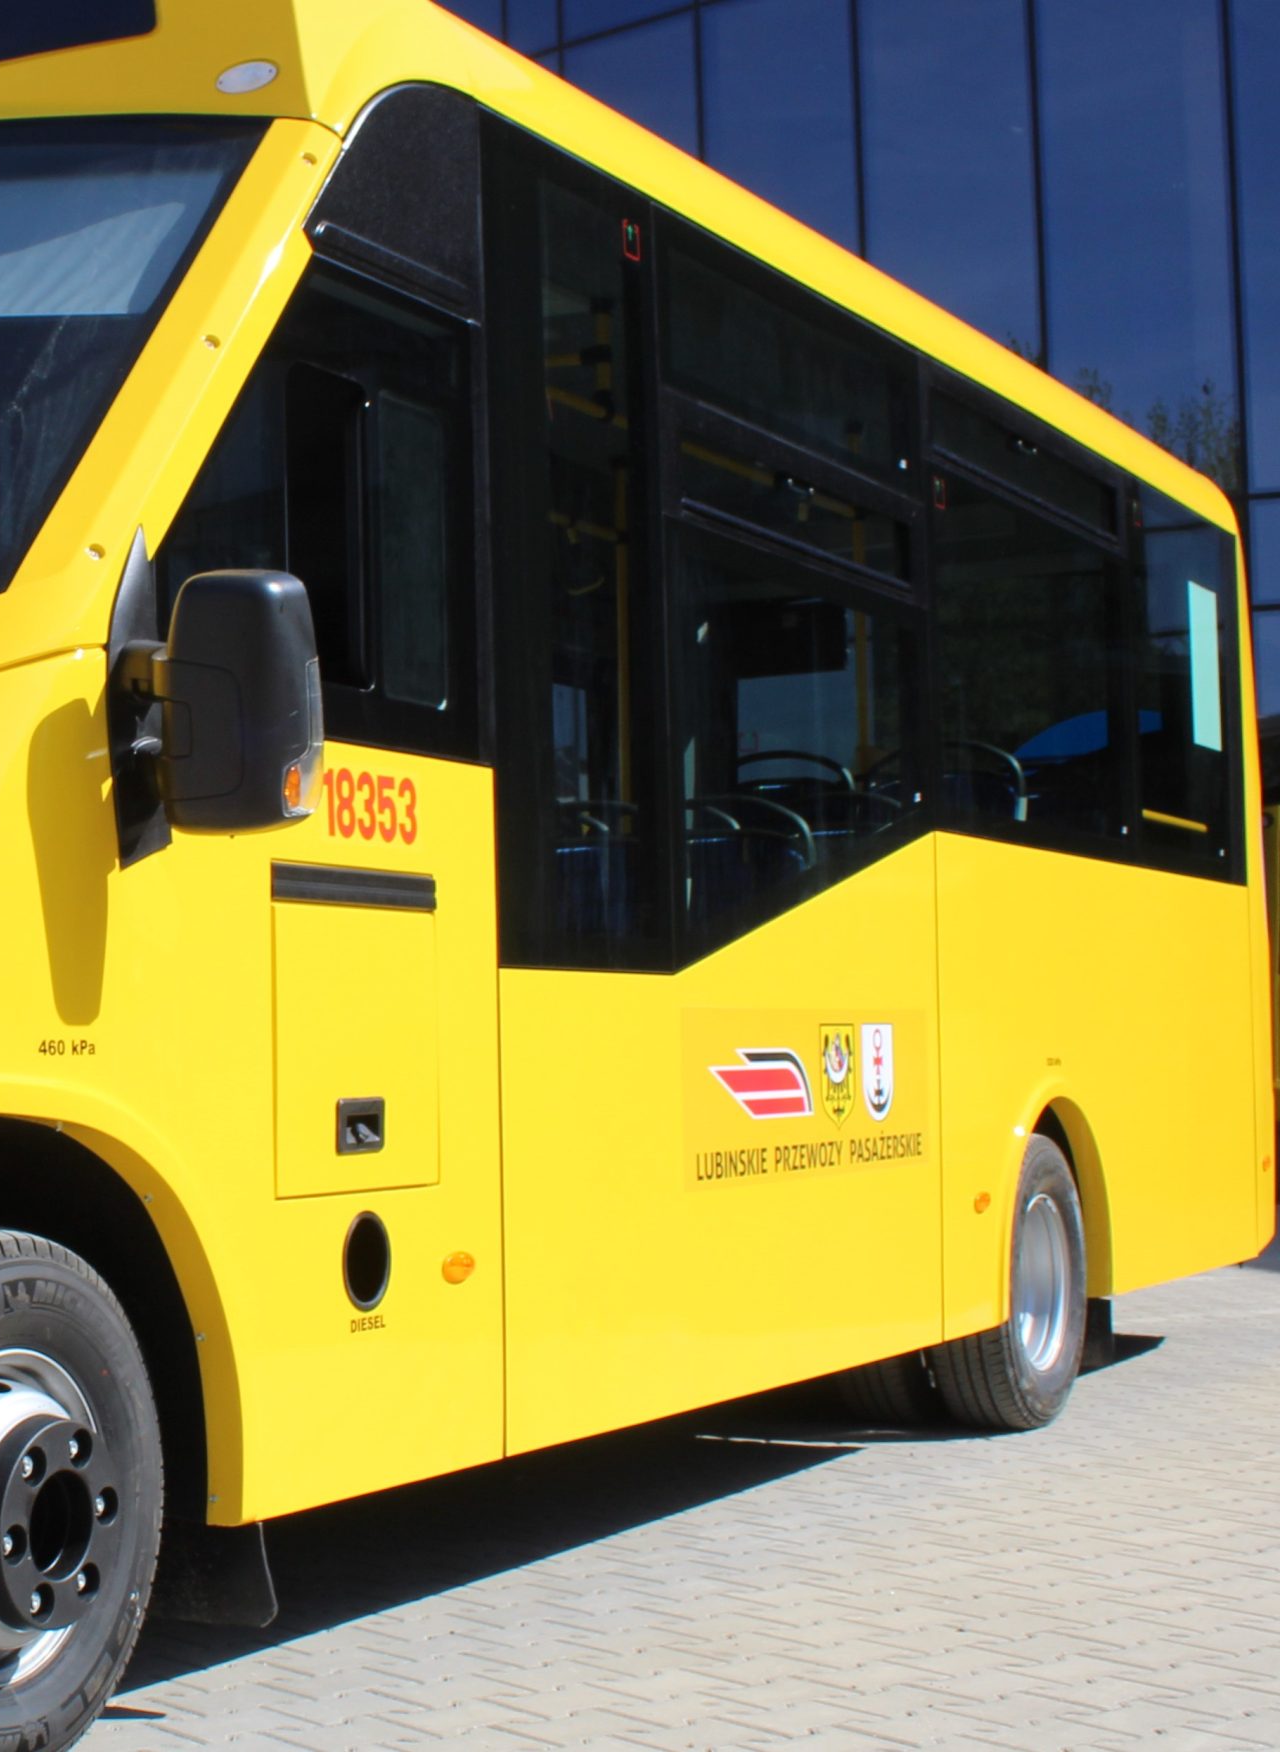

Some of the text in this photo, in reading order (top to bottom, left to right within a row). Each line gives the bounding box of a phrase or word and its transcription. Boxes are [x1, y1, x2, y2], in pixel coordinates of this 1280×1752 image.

[323, 767, 418, 845] 18353
[38, 1039, 96, 1056] 460 kPa
[696, 1130, 922, 1181] LUBINSKIE PRZEWOZY PASAŻERSKIE
[350, 1315, 386, 1333] DIESEL
